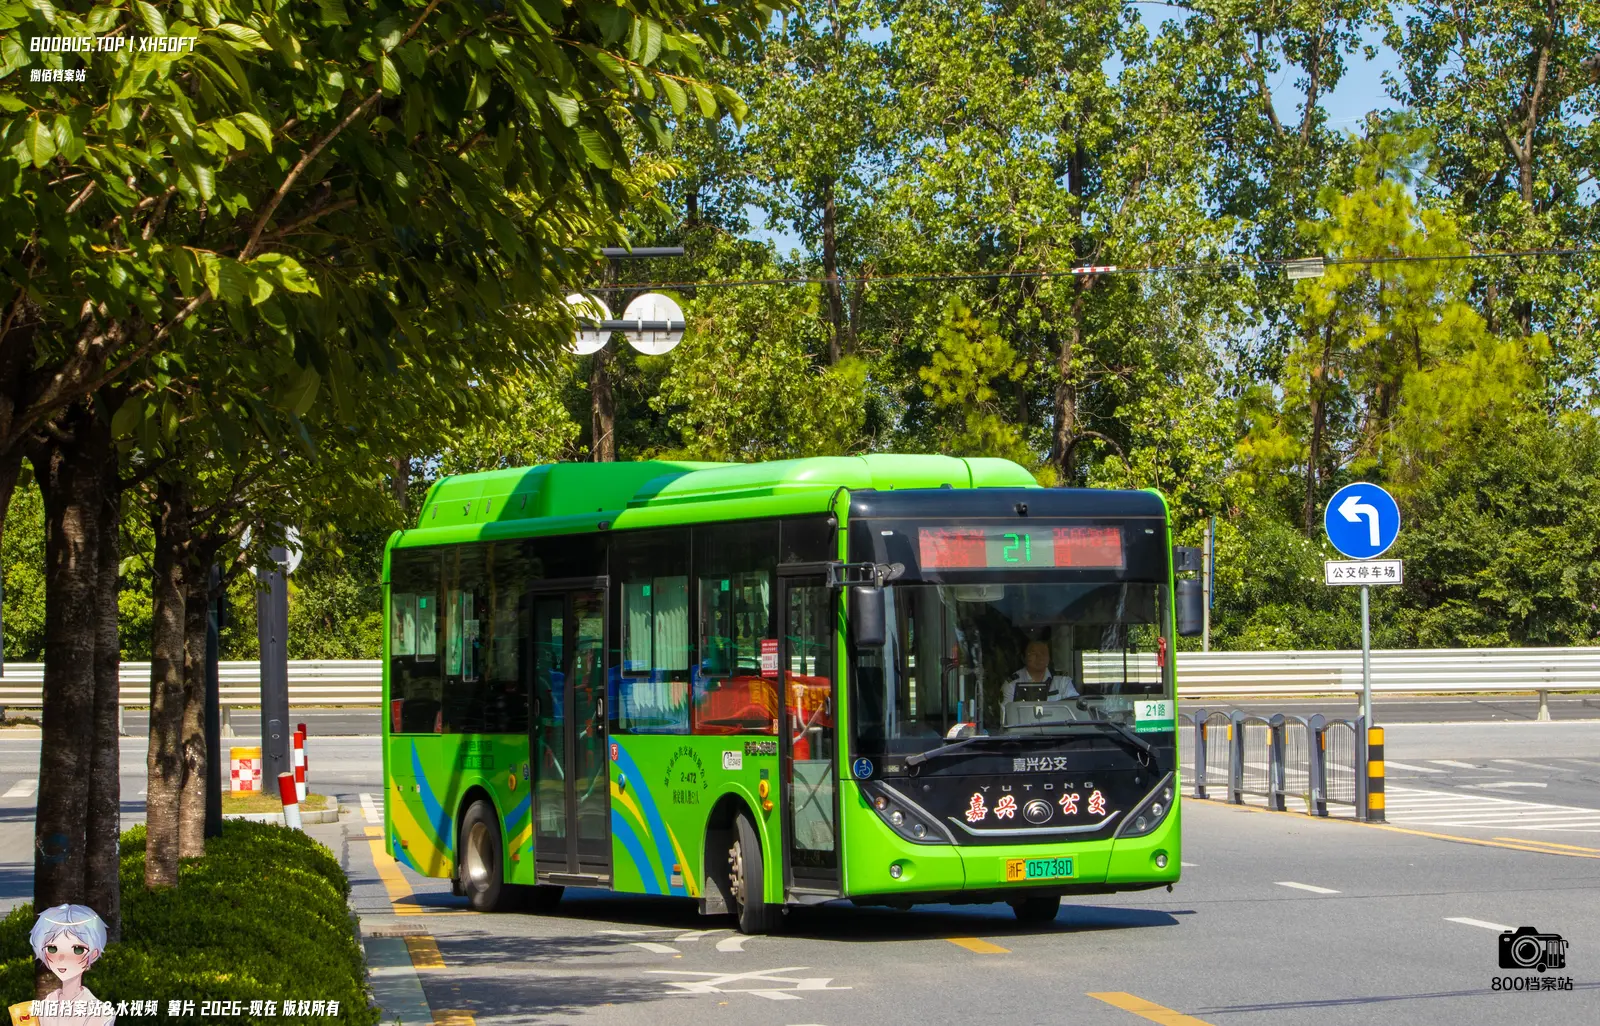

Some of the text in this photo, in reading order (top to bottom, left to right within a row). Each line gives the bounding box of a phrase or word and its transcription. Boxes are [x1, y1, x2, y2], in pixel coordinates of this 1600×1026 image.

[1003, 533, 1031, 562] 21
[1333, 566, 1396, 578] 公交停车场
[1145, 703, 1166, 717] 21路
[1013, 757, 1068, 772] 嘉兴公交
[981, 782, 1094, 792] YUTONG
[965, 790, 1106, 822] 嘉兴 公交
